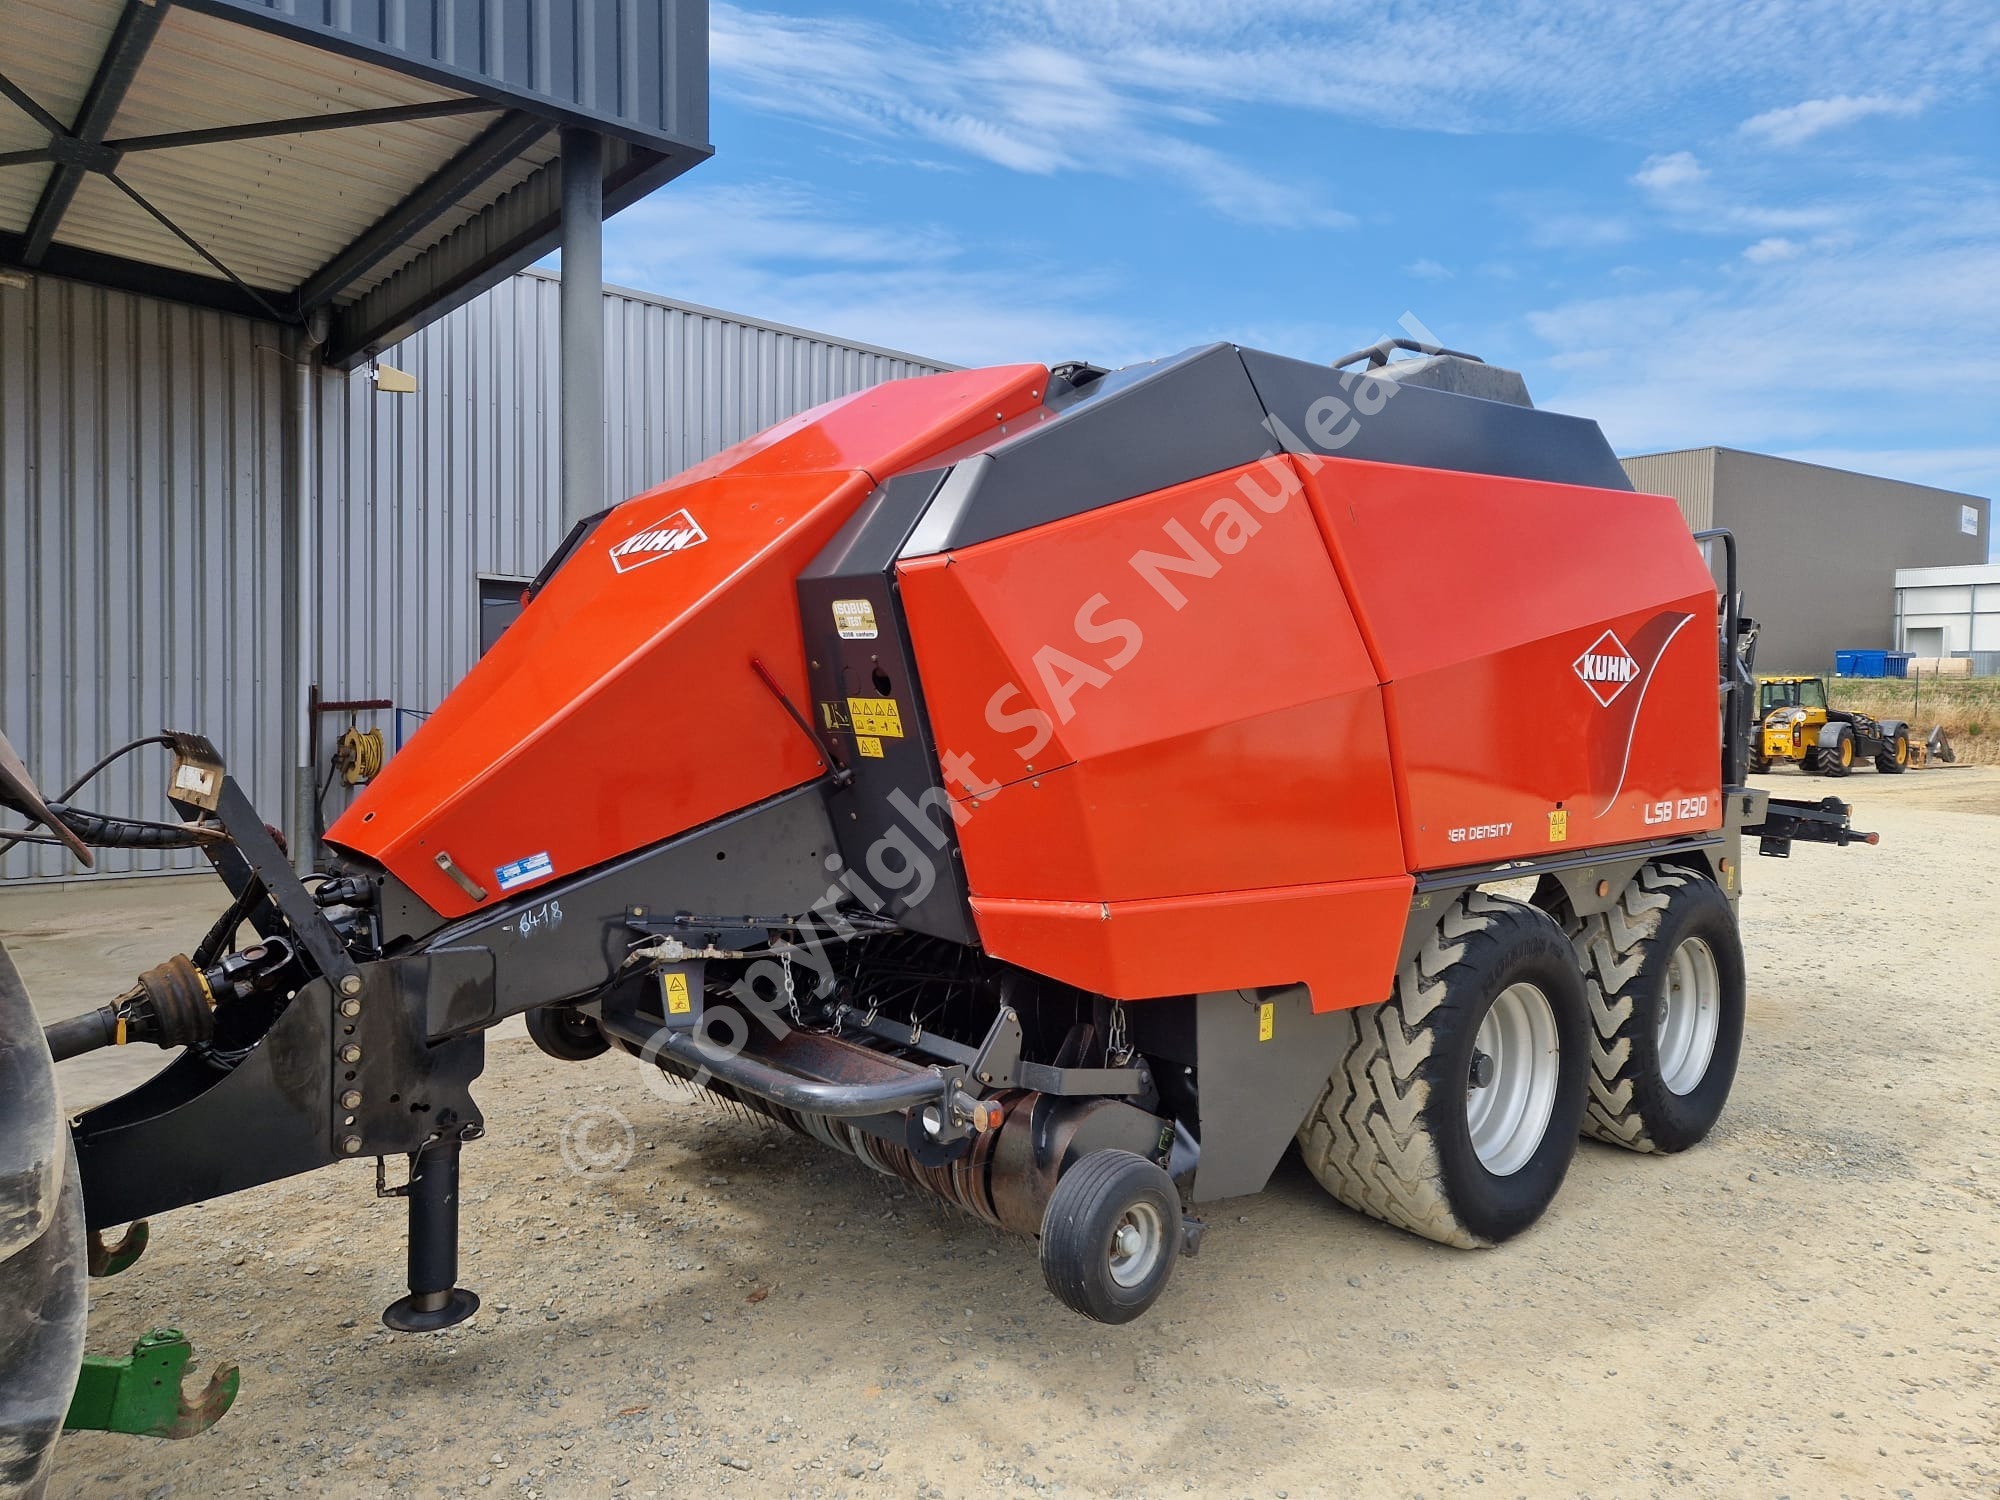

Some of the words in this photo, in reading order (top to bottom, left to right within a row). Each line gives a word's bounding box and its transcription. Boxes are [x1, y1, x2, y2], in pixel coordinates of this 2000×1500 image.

[613, 528, 699, 557] KUHN
[1583, 654, 1632, 682] KUHN
[1645, 801, 1672, 824] LSB
[1676, 796, 1707, 819] 1290
[1448, 828, 1466, 842] ER
[1469, 822, 1512, 840] DENSITY
